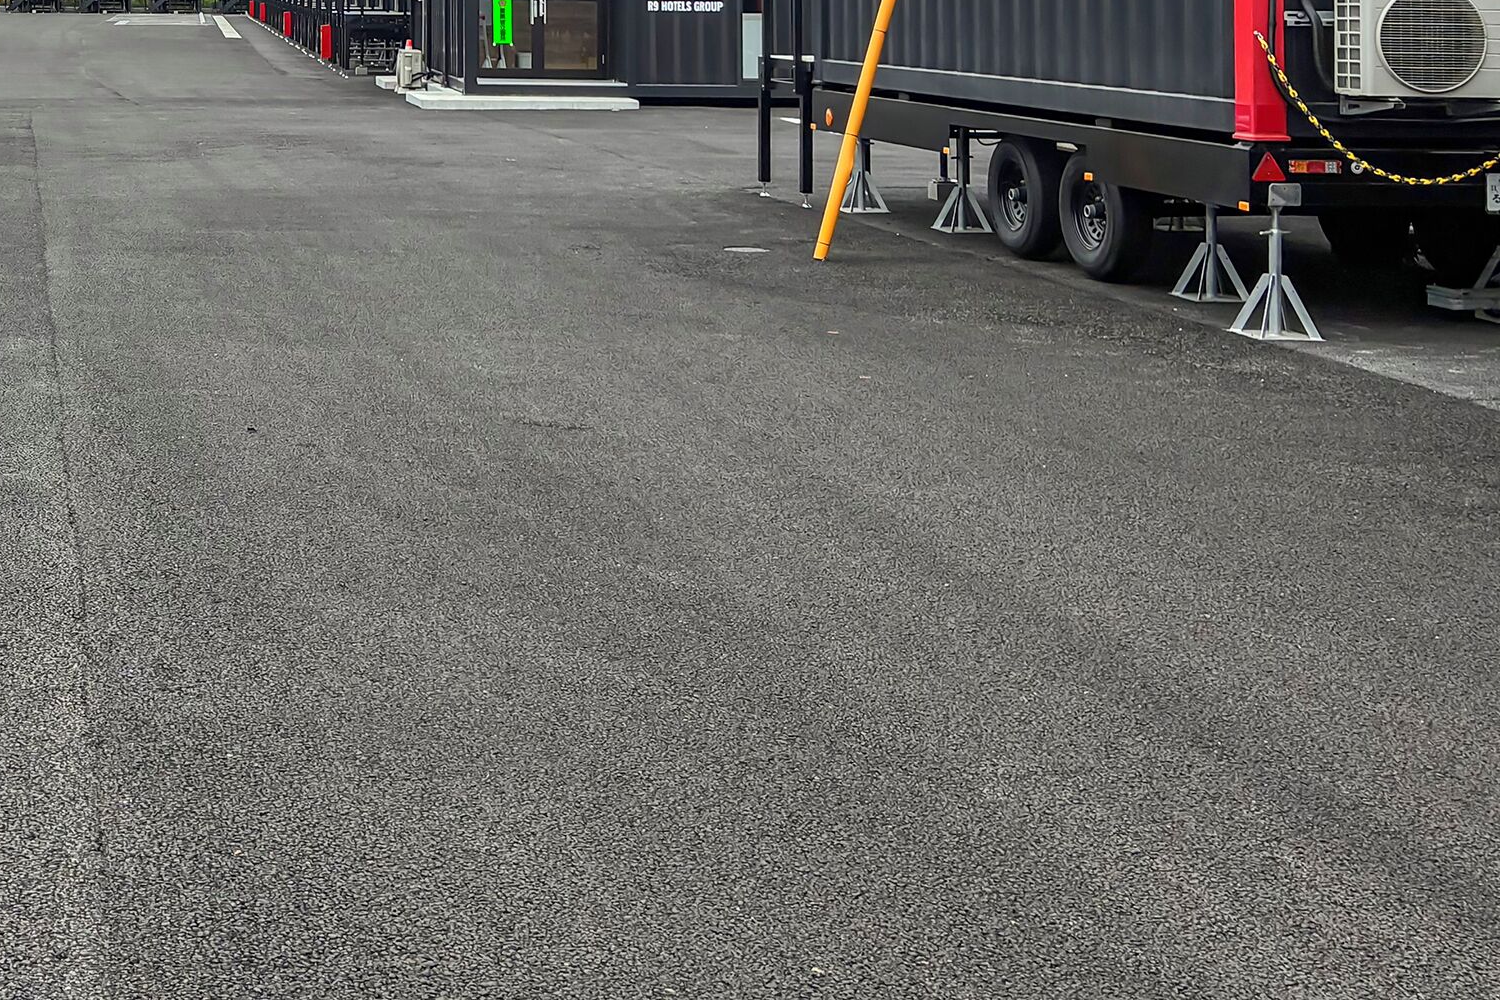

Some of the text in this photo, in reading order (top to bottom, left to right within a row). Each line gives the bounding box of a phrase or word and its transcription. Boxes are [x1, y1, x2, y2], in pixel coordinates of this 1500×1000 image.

[647, 1, 724, 12] R9 HOTELS GROUP
